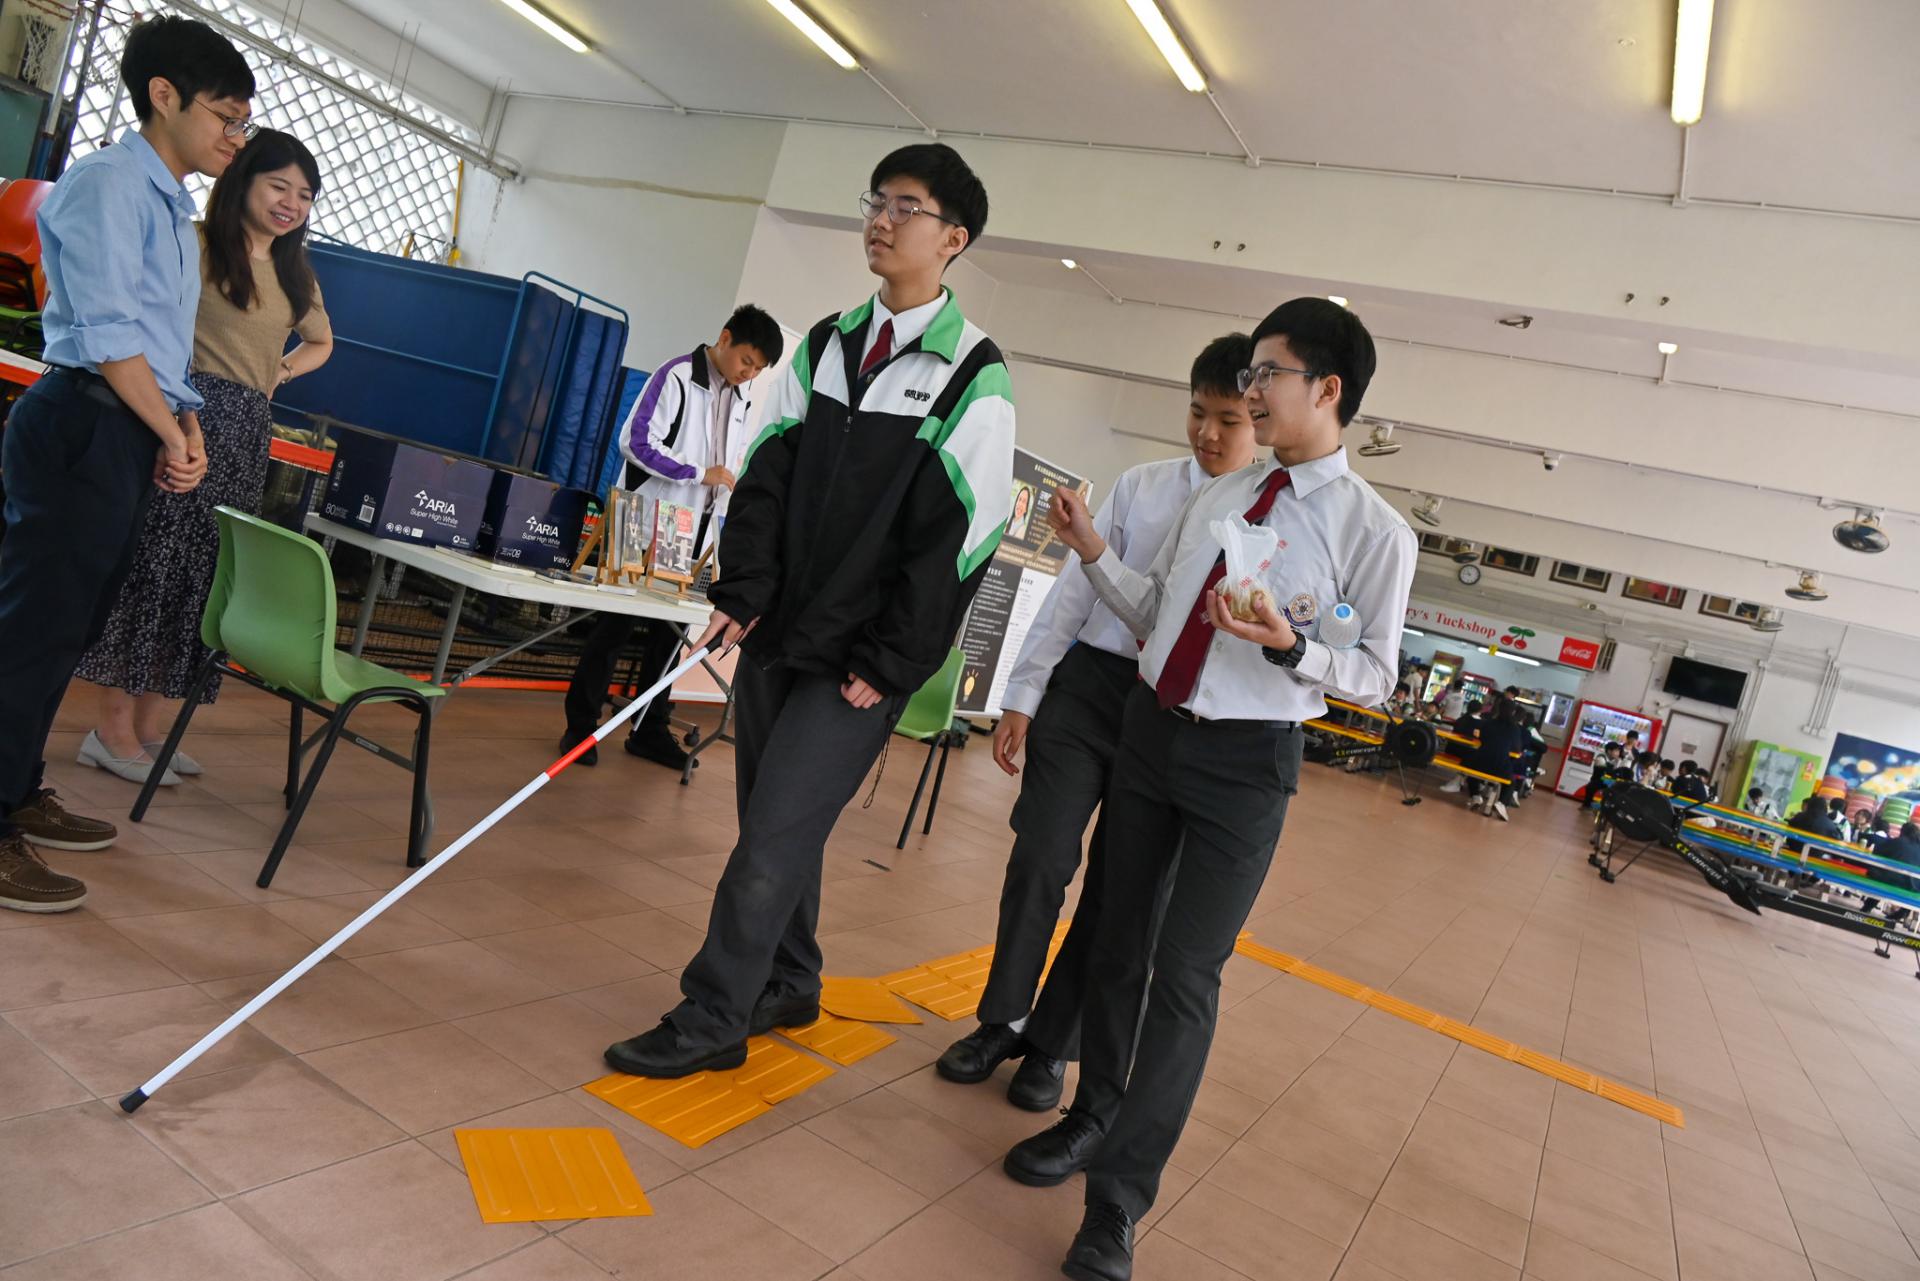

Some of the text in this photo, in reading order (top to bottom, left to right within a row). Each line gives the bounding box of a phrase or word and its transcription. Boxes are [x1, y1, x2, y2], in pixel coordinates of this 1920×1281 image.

[326, 503, 336, 515] 80
[425, 499, 456, 516] ARIA
[410, 508, 428, 518] Super
[428, 512, 442, 521] High
[442, 515, 458, 525] White
[535, 523, 559, 537] ARIA
[522, 532, 536, 541] Super
[537, 536, 547, 544] High
[1406, 607, 1496, 638] ry's Tuckshop
